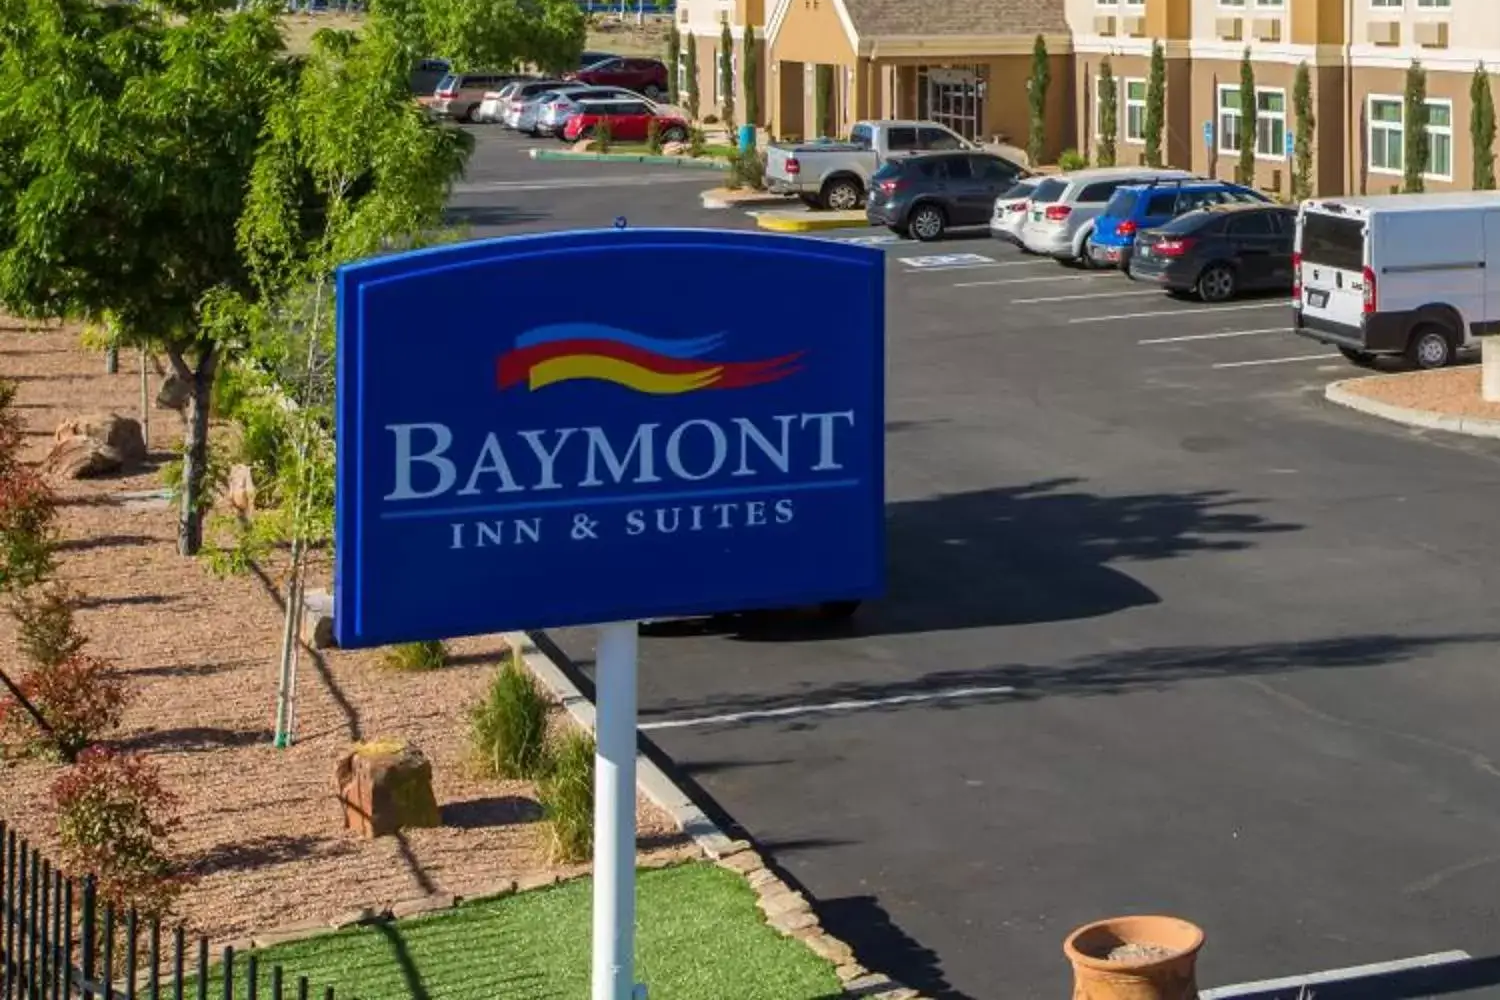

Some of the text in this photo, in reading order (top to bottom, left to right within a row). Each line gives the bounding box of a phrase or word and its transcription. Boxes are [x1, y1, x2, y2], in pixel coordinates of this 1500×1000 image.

[383, 409, 855, 502] BAYMONT
[449, 499, 796, 549] INN & SUITES
